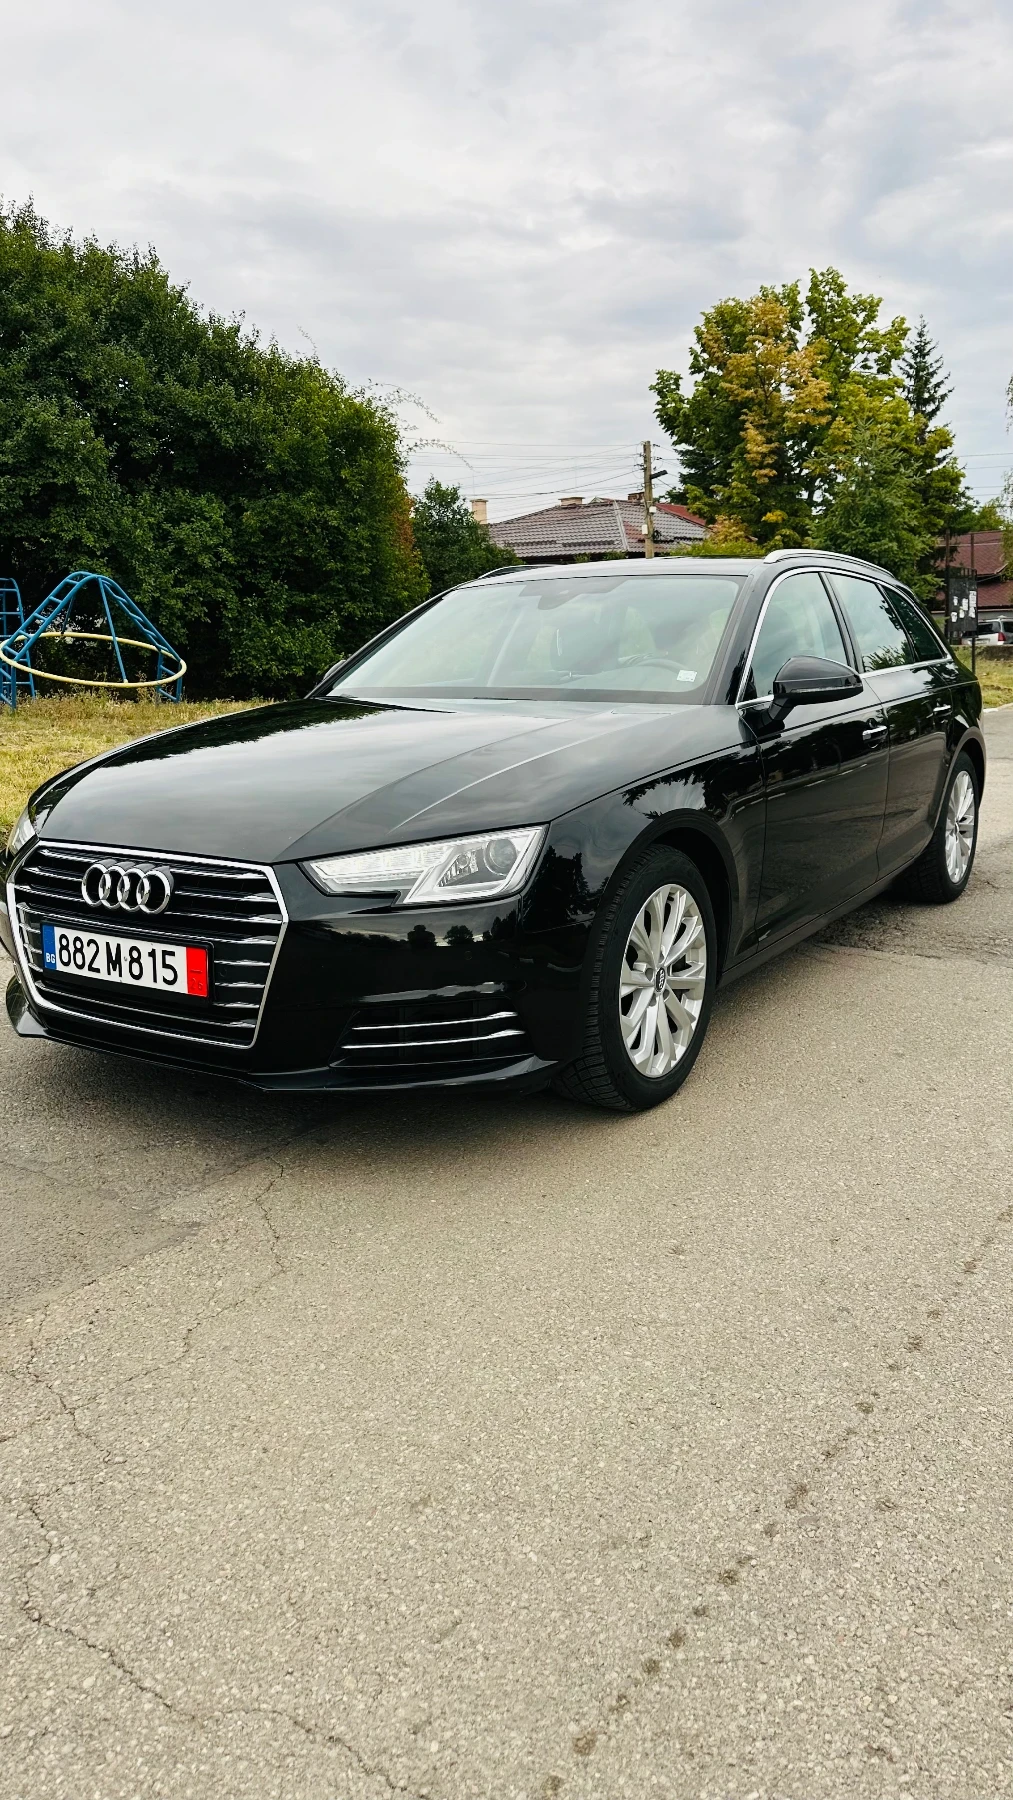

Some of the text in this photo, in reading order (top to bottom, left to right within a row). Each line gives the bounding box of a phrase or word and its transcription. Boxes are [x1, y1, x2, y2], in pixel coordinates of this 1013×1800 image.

[45, 952, 56, 963] BG
[58, 933, 178, 985] 882 M 815
[190, 977, 203, 990] 26
